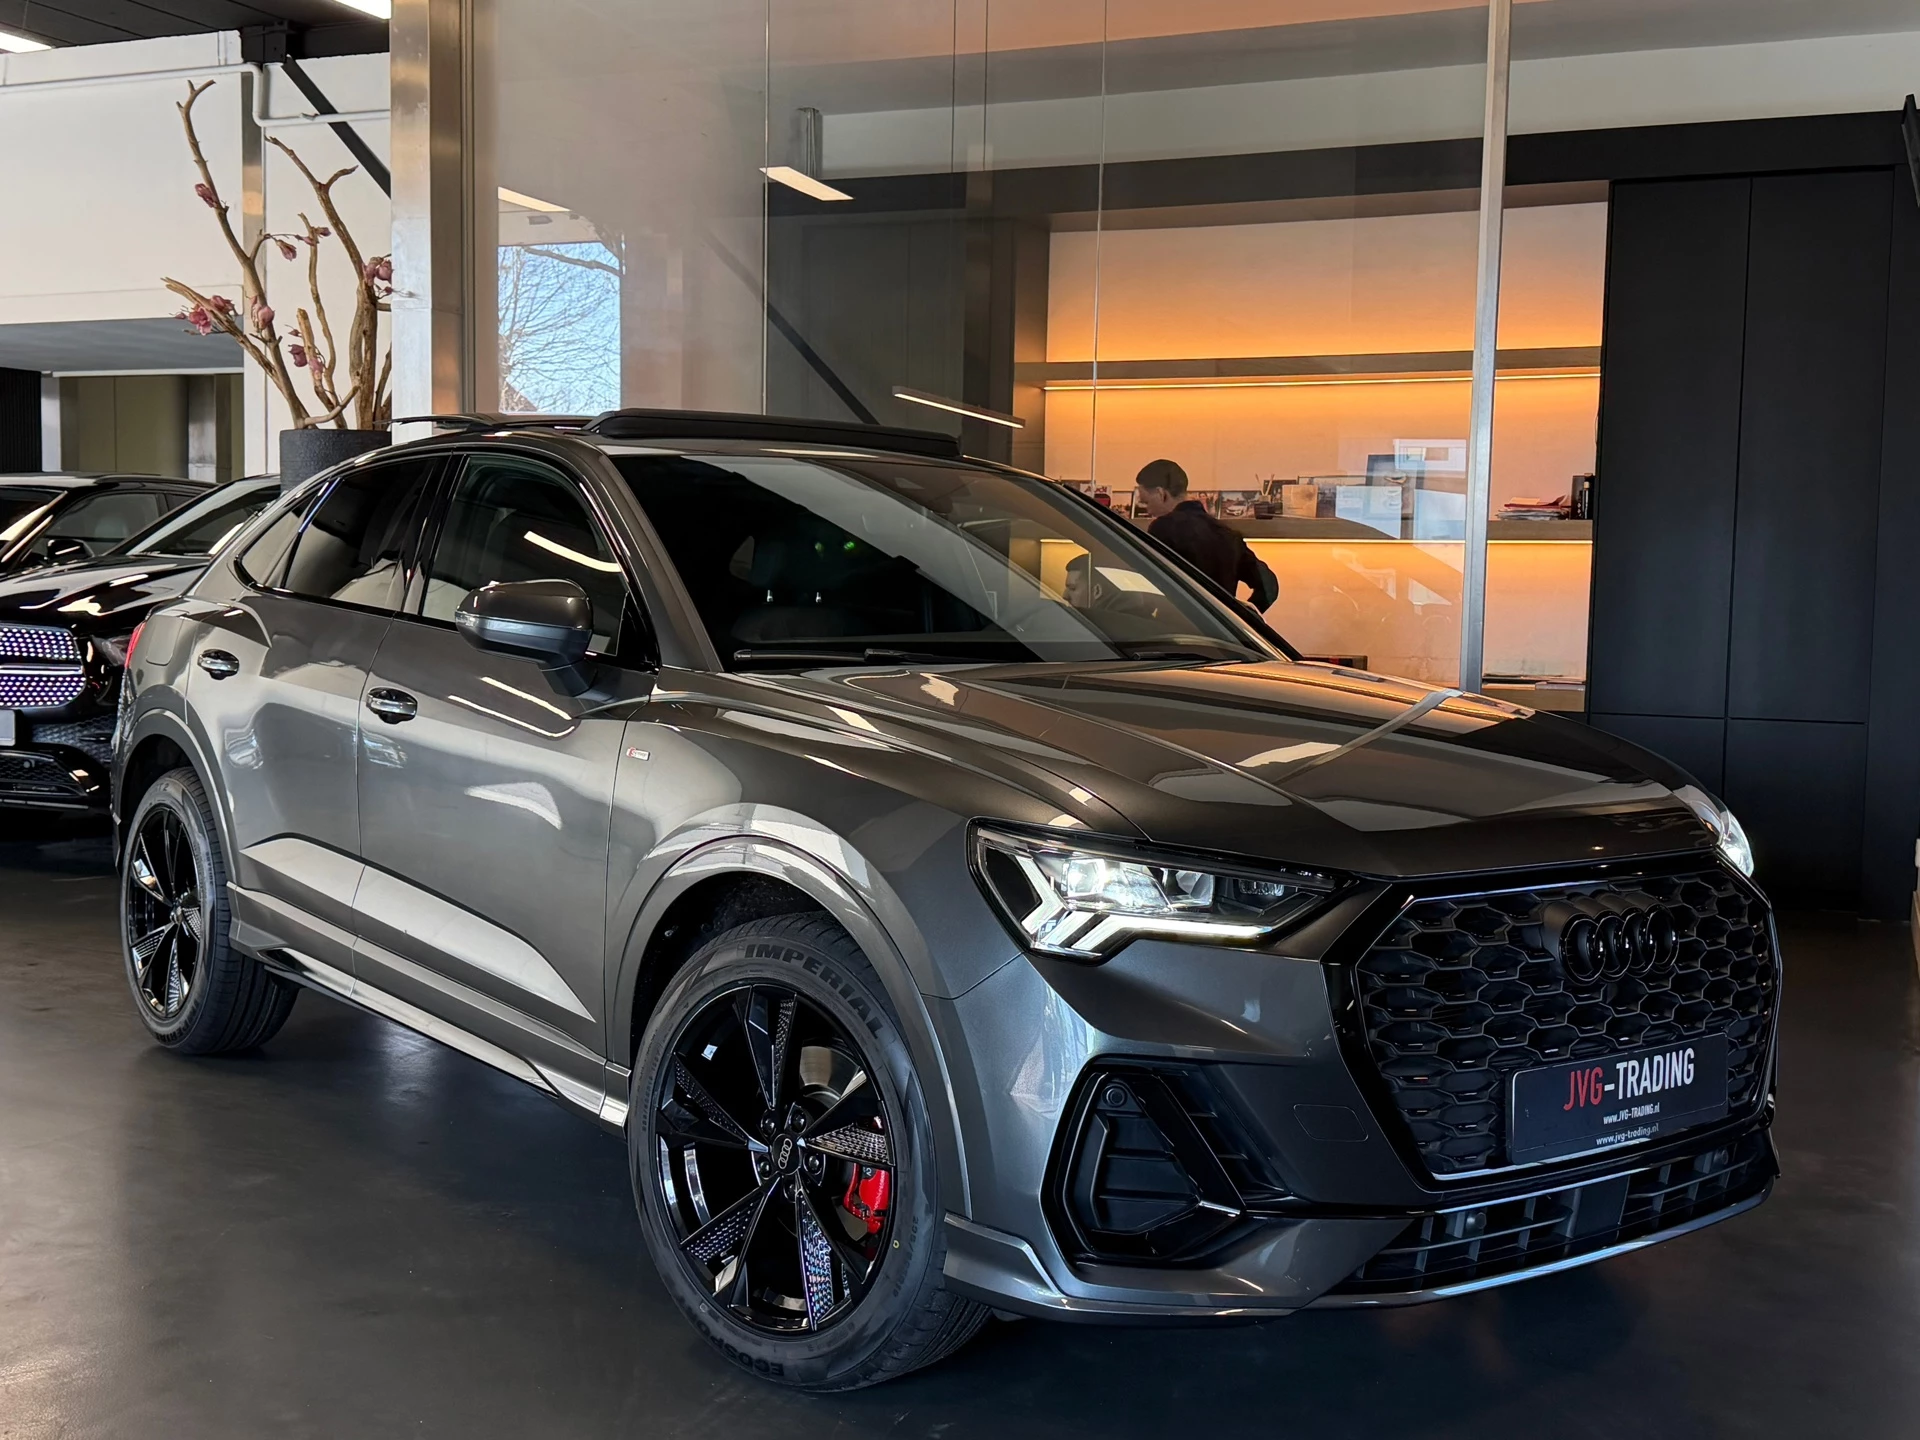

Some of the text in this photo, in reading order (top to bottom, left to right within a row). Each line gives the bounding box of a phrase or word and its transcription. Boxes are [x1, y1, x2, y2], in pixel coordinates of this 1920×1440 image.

[744, 943, 886, 1039] IMPERIAL
[1563, 1047, 1695, 1111] JVG-TRADING
[1596, 1123, 1660, 1145] www.jvg-trading.nl
[1603, 1102, 1660, 1125] www.JVG-TRADING.nl
